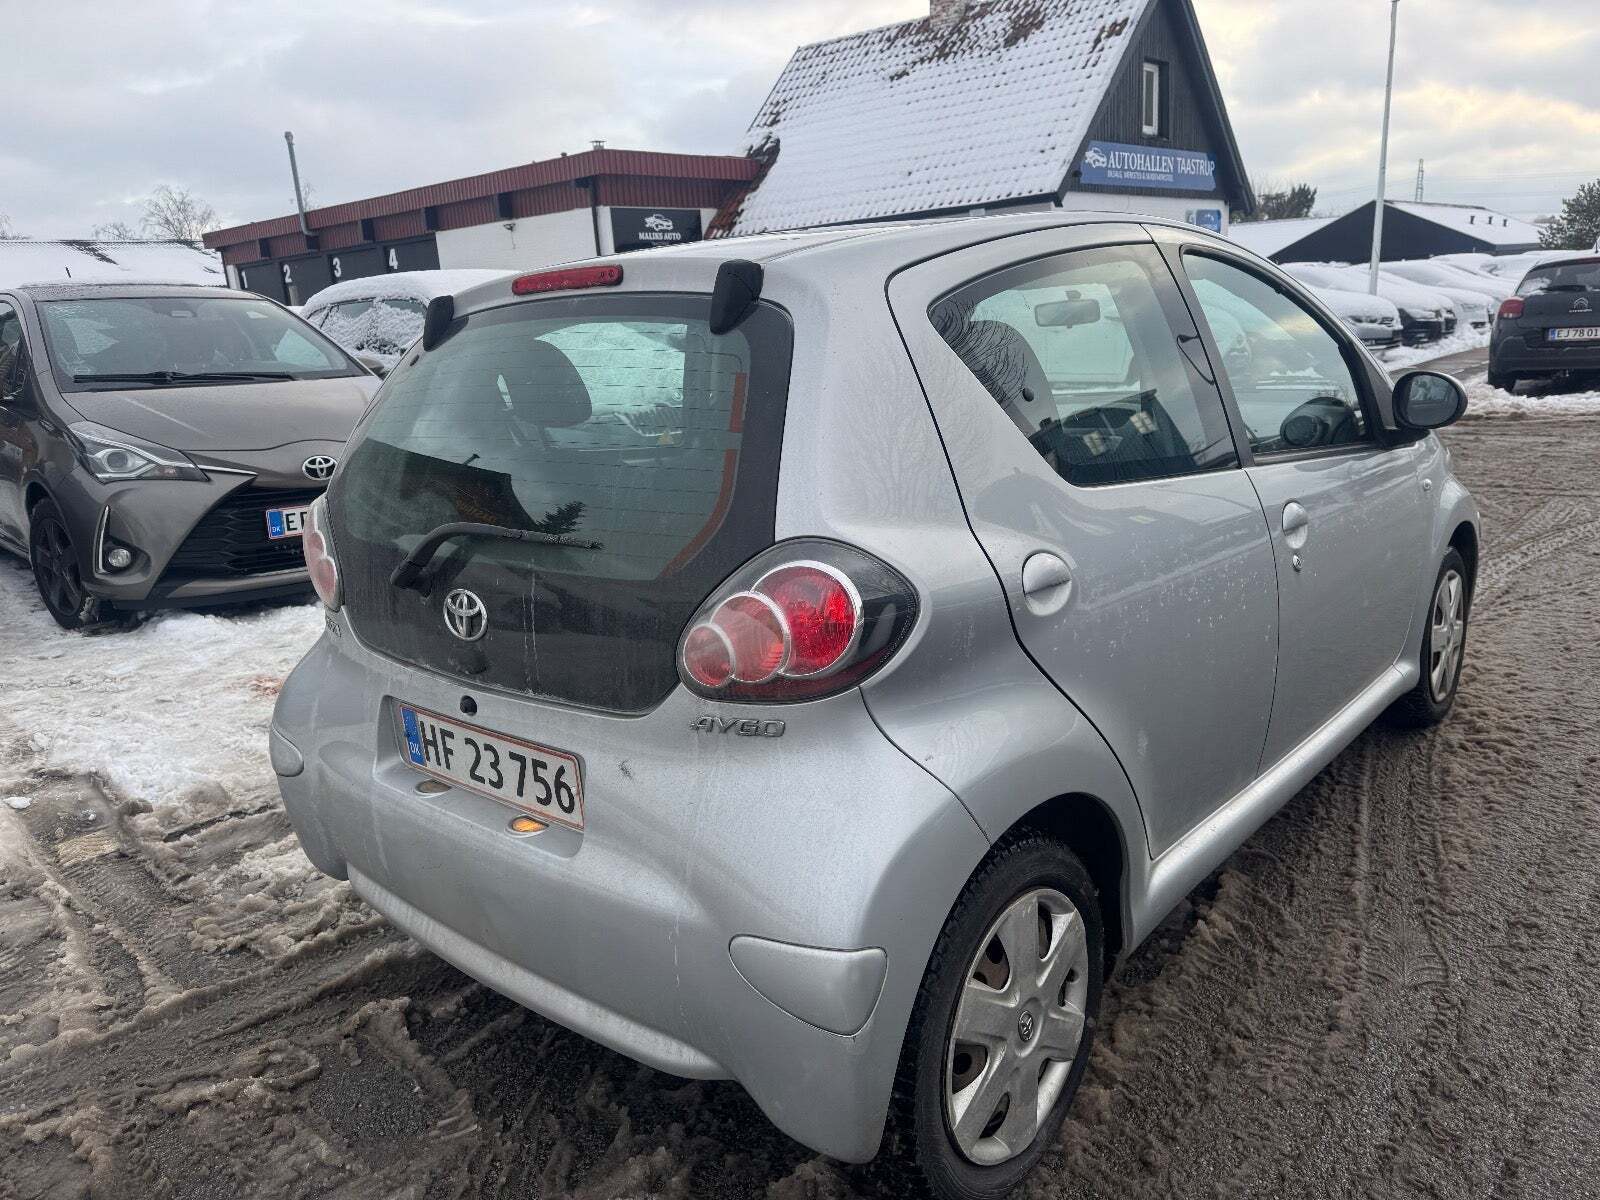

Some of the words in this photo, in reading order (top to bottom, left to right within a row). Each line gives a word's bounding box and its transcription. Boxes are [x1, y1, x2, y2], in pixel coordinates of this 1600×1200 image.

[1107, 151, 1174, 173] AUTOHALLEN
[1177, 157, 1215, 177] TAASTRUP
[664, 232, 681, 240] AUTO
[333, 257, 342, 277] 3
[389, 249, 398, 269] 4
[241, 271, 248, 288] 1
[283, 264, 292, 283] 2
[1557, 329, 1569, 338] EJ
[1572, 329, 1585, 337] 78
[688, 716, 786, 737] AYGO
[409, 742, 421, 756] DK
[420, 721, 455, 770] HF
